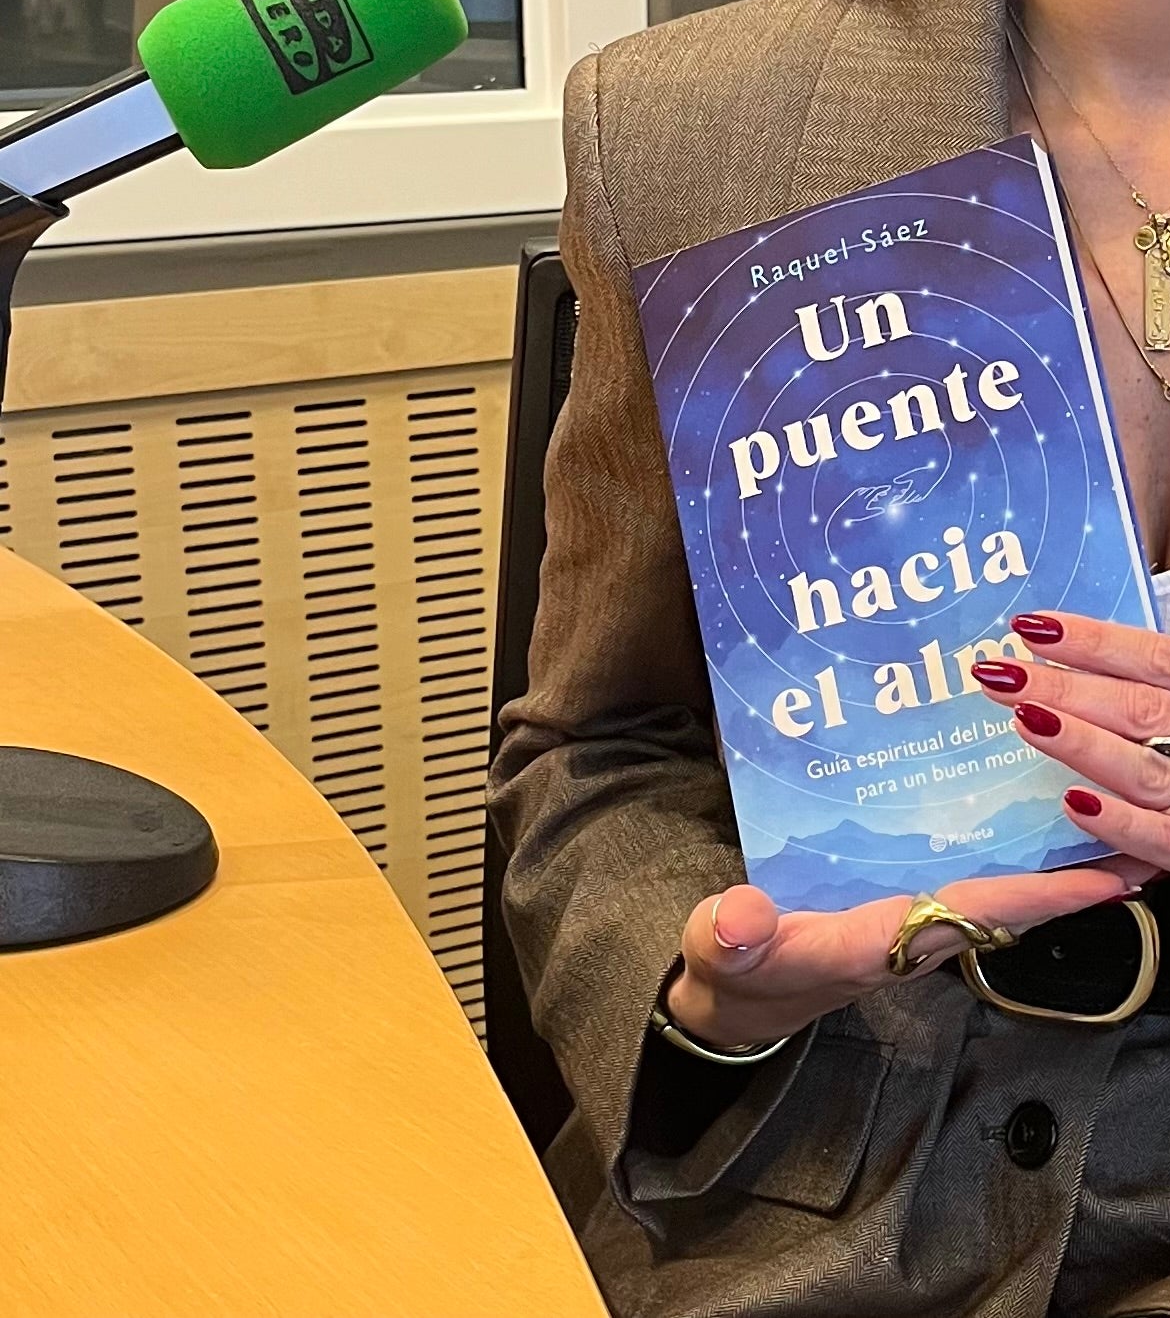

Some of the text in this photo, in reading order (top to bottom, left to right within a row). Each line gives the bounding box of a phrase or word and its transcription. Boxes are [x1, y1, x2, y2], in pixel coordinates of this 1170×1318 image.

[750, 218, 929, 288] Raquel Sáez
[795, 291, 912, 362] Un
[728, 358, 1023, 499] puente
[787, 526, 1030, 634] hacia
[771, 632, 1072, 739] el alm
[806, 718, 1017, 779] Guía espiritual del bue
[855, 782, 899, 806] para
[903, 772, 927, 789] un
[931, 760, 979, 782] buen
[947, 827, 994, 846] Planeta
